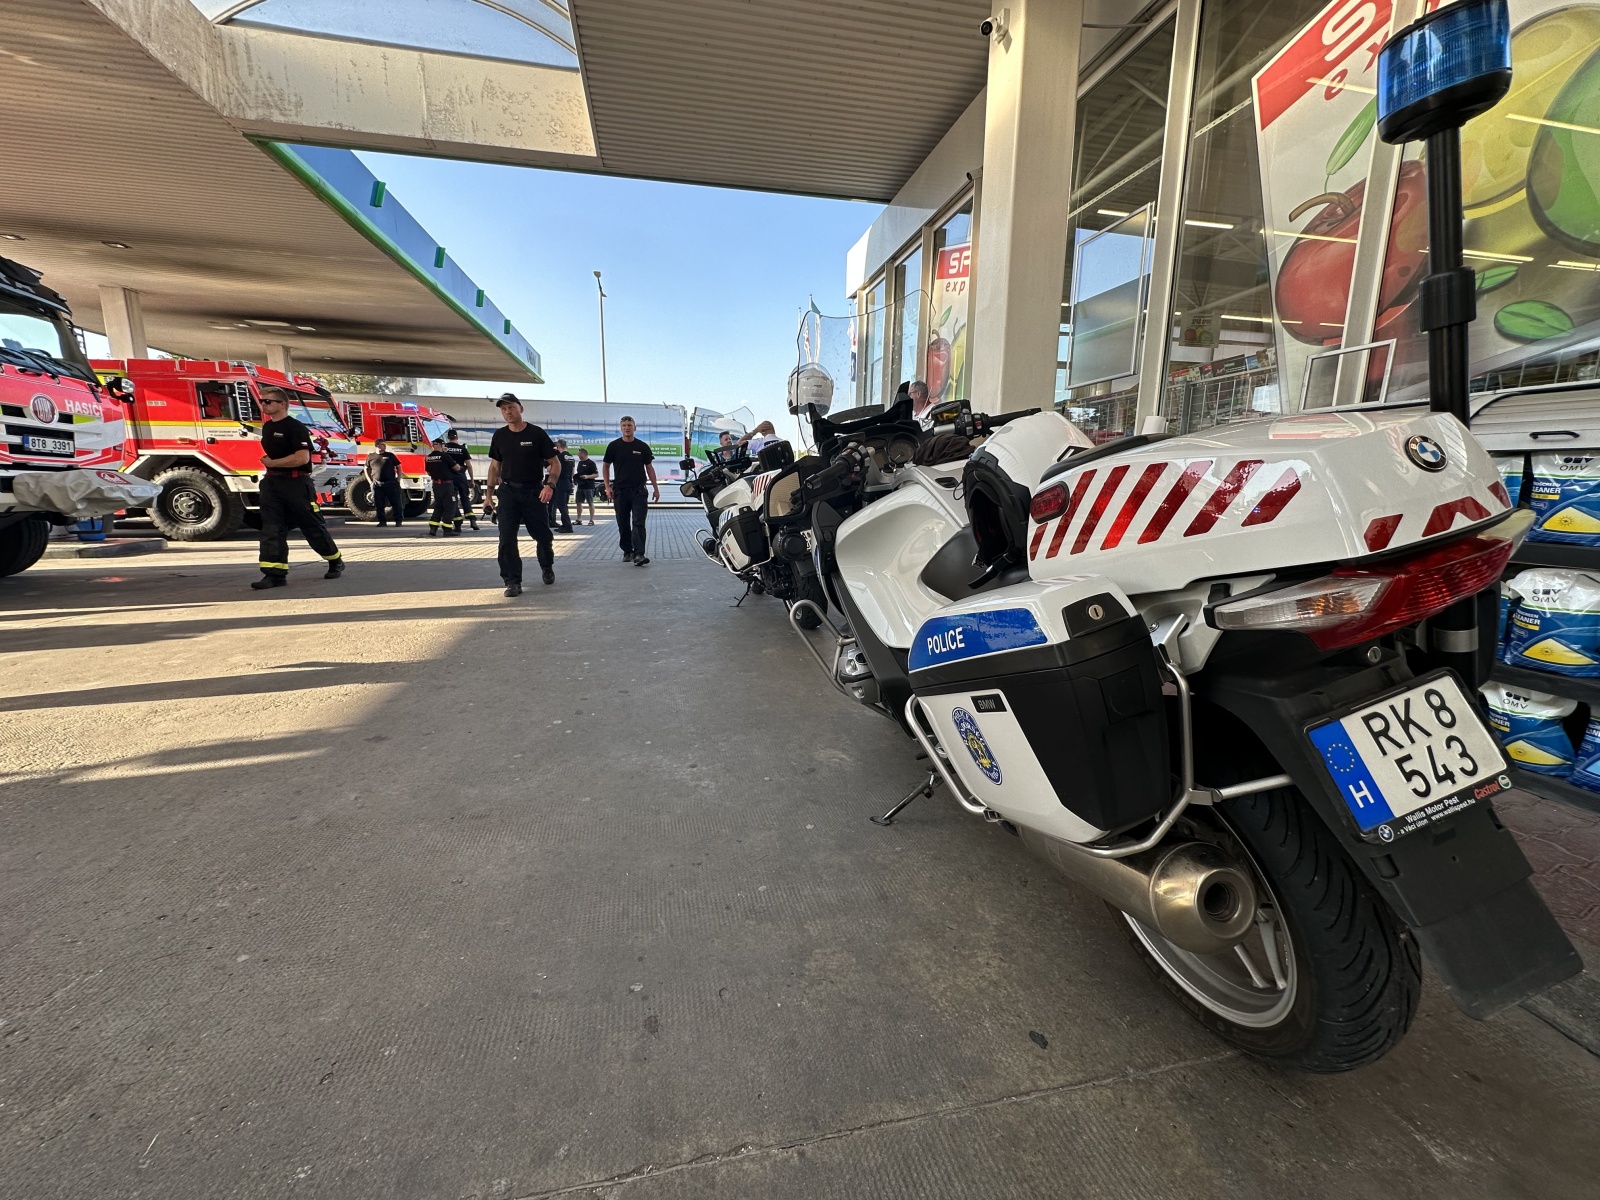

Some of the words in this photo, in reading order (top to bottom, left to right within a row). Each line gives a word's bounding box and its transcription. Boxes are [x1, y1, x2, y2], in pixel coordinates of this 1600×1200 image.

[64, 399, 103, 417] HASIČI
[31, 438, 47, 449] 8T8
[52, 440, 71, 451] 3391
[1531, 486, 1561, 494] LEANER
[1531, 595, 1560, 603] OMV
[926, 626, 966, 656] POLICE
[977, 699, 996, 710] BMW
[1502, 698, 1529, 710] OMV
[1361, 698, 1433, 757] RK
[1424, 688, 1457, 729] 8
[1394, 734, 1479, 799] 543
[1348, 780, 1375, 809] H
[1473, 780, 1501, 800] Castrol
[1404, 810, 1426, 824] Wallis
[1424, 802, 1446, 816] Motor
[1443, 795, 1460, 808] Pest
[1430, 798, 1476, 821] www.wallispest.hu
